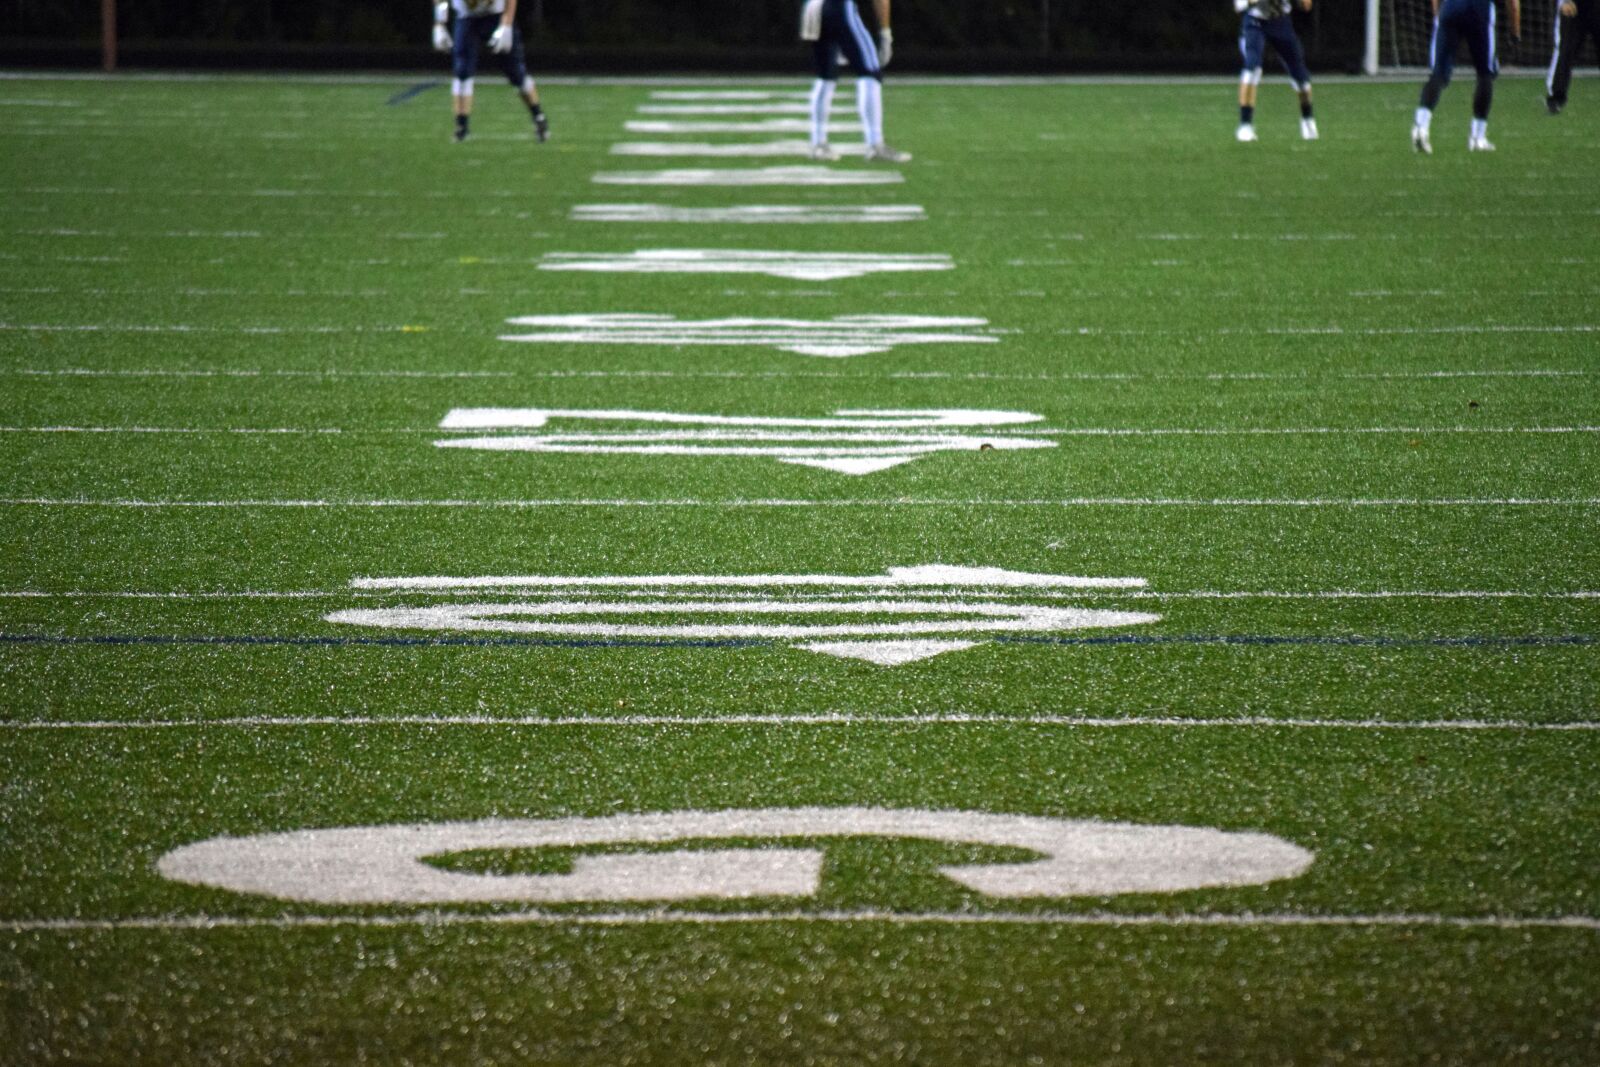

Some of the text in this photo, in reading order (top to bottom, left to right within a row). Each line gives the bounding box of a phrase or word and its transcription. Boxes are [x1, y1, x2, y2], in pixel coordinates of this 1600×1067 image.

[498, 313, 1000, 344] 30
[433, 408, 1059, 456] 20
[321, 564, 1162, 637] 10
[157, 806, 1315, 904] G
